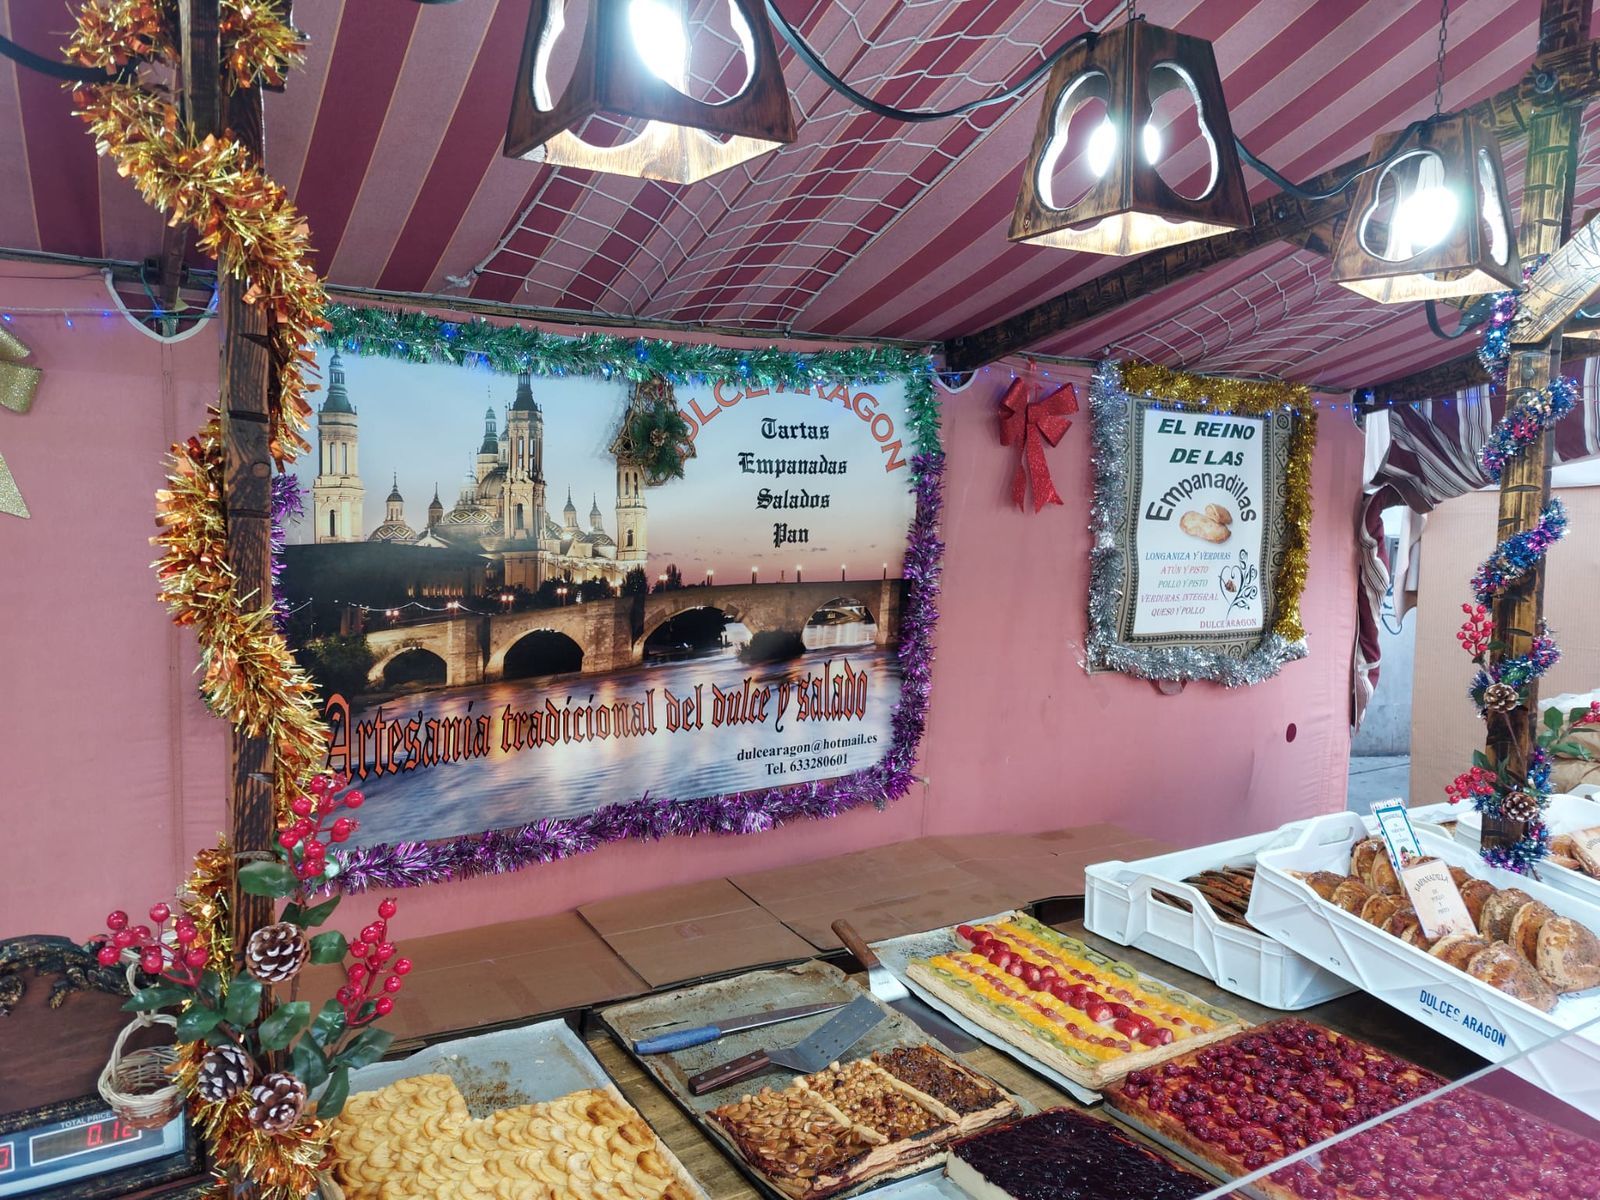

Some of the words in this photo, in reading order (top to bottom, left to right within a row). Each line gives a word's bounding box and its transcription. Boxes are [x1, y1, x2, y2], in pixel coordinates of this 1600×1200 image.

[760, 417, 829, 440] Tartas
[1157, 418, 1187, 435] EL
[1193, 421, 1255, 440] REINO
[738, 452, 848, 478] Empanadas
[1169, 448, 1201, 464] DE
[1203, 450, 1244, 466] LAS
[756, 488, 830, 510] Salados
[1145, 472, 1257, 522] Empanadillas
[773, 522, 809, 548] Pan
[1145, 551, 1190, 561] LONGANIZA
[501, 688, 657, 753] tradicional
[664, 682, 704, 733] del
[711, 676, 771, 728] dulce
[775, 682, 791, 733] y
[796, 657, 868, 722] salado
[736, 734, 878, 761] dulcearagon@hotmail.es
[765, 762, 787, 775] Tel.
[789, 753, 848, 772] 633280601
[1419, 989, 1461, 1022] DULCES
[1461, 1014, 1507, 1047] ARAGON
[60, 1117, 87, 1129] TOTAL
[87, 1112, 112, 1124] PRICE
